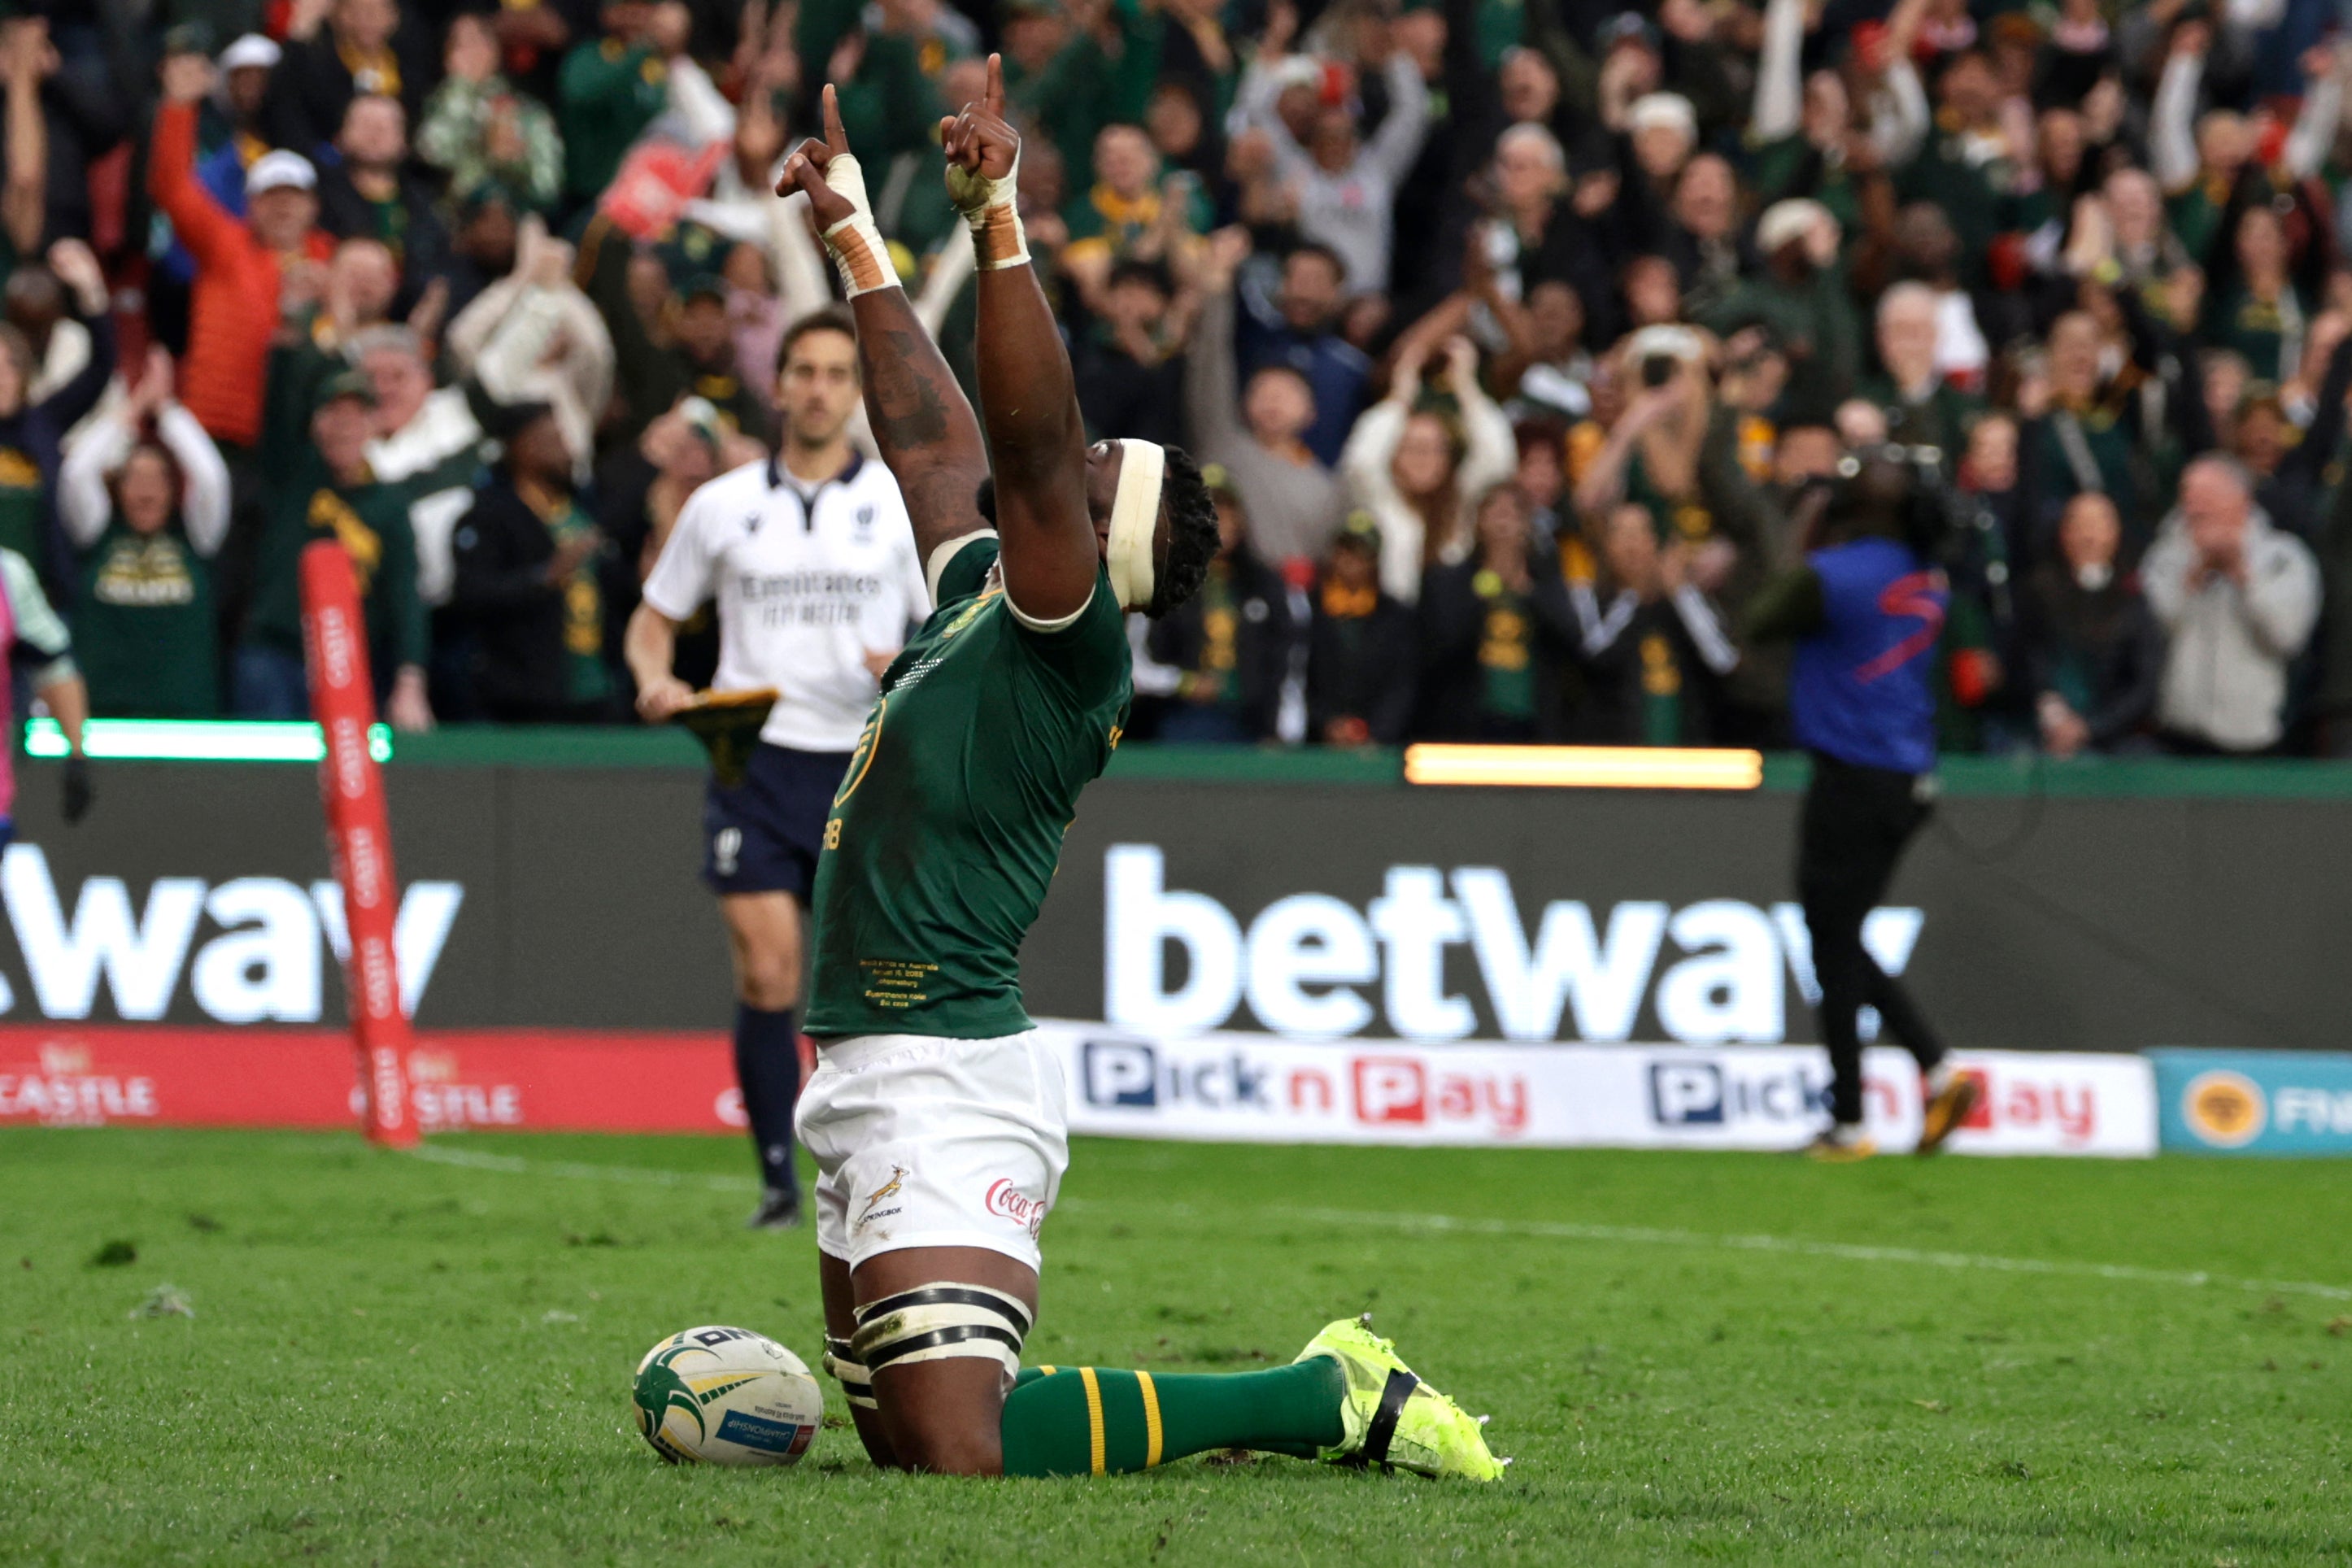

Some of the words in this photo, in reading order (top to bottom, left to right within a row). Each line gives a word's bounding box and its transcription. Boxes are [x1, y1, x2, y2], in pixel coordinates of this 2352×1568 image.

[0, 843, 464, 1025] way
[1082, 1039, 1273, 1109] Pick
[1289, 1067, 1332, 1112] n
[1350, 1056, 1527, 1137] Pay
